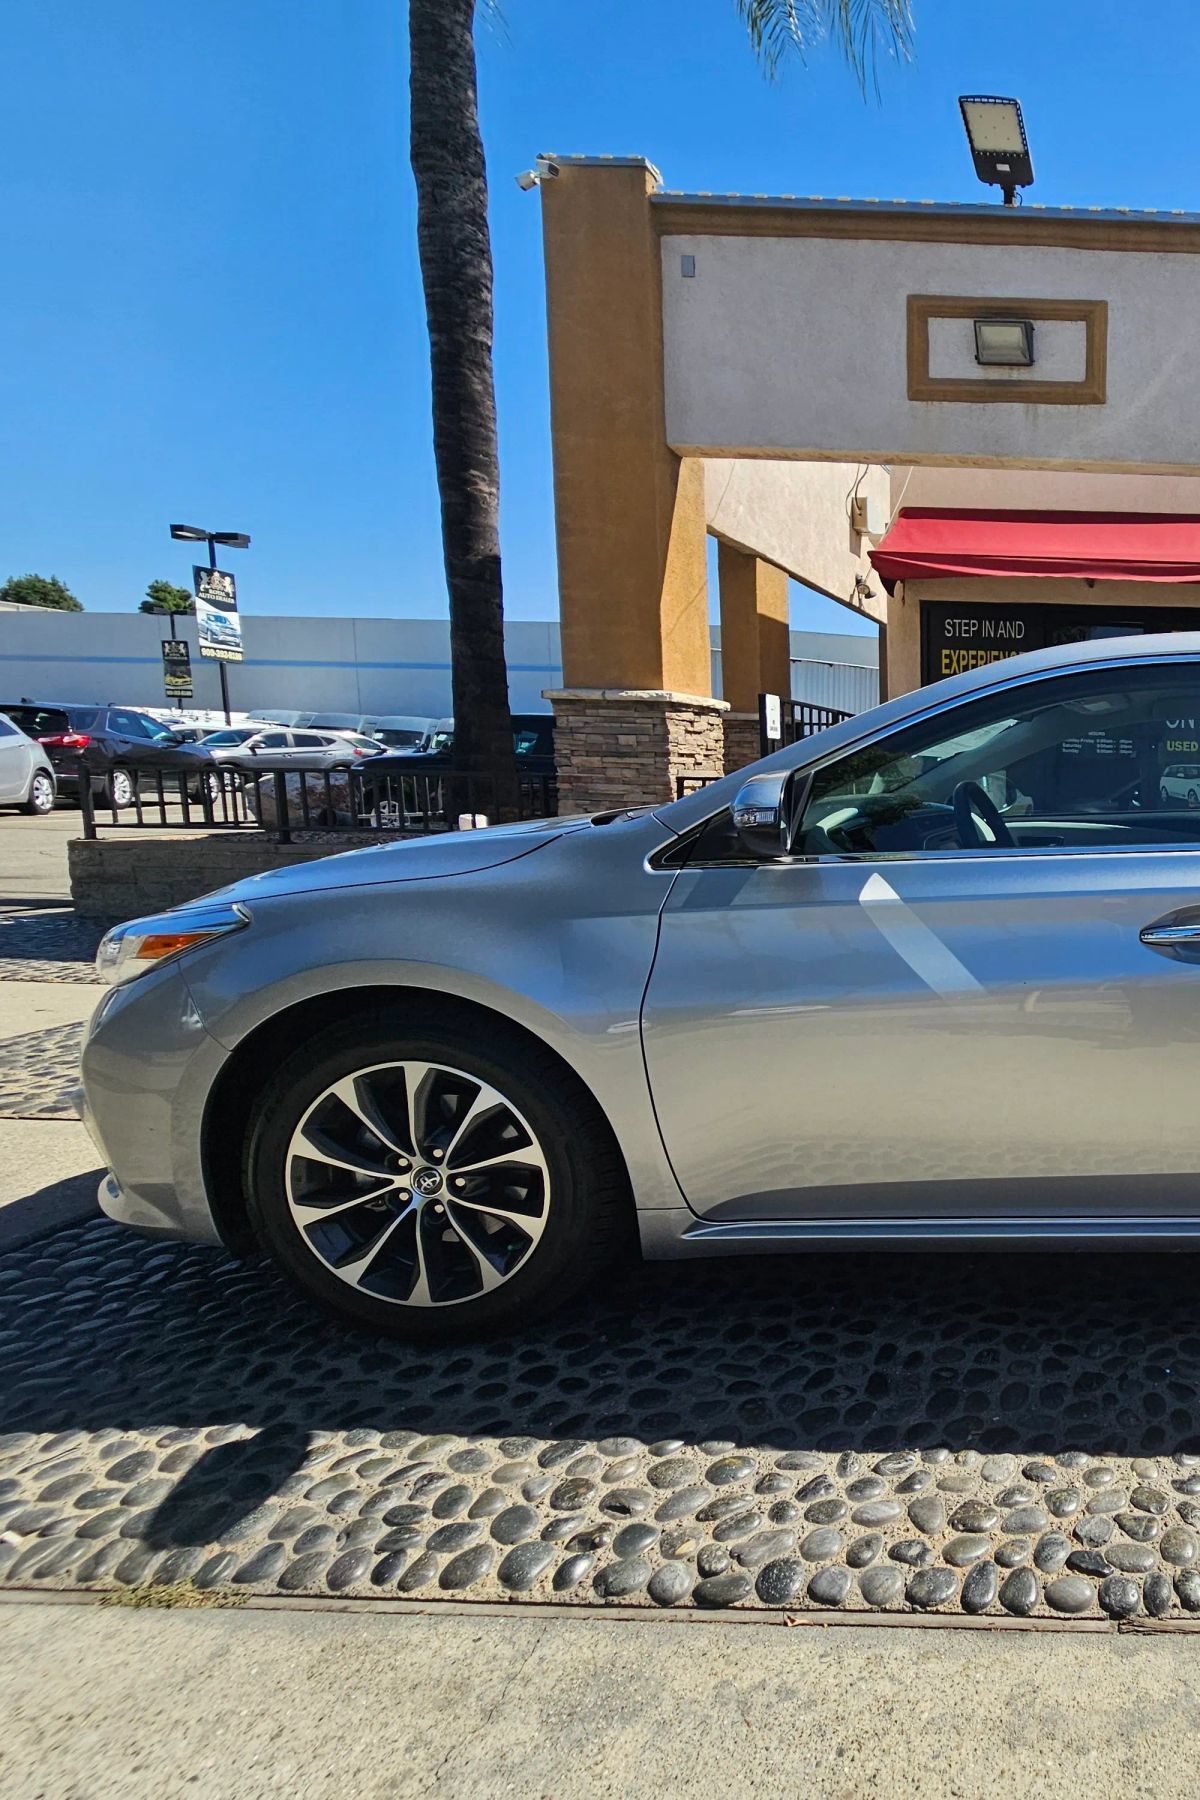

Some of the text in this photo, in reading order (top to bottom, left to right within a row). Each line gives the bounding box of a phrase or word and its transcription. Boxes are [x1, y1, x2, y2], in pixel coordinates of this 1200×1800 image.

[199, 592, 216, 600] AUTO
[944, 618, 1025, 639] STEP IN AND
[1166, 740, 1199, 752] USED
